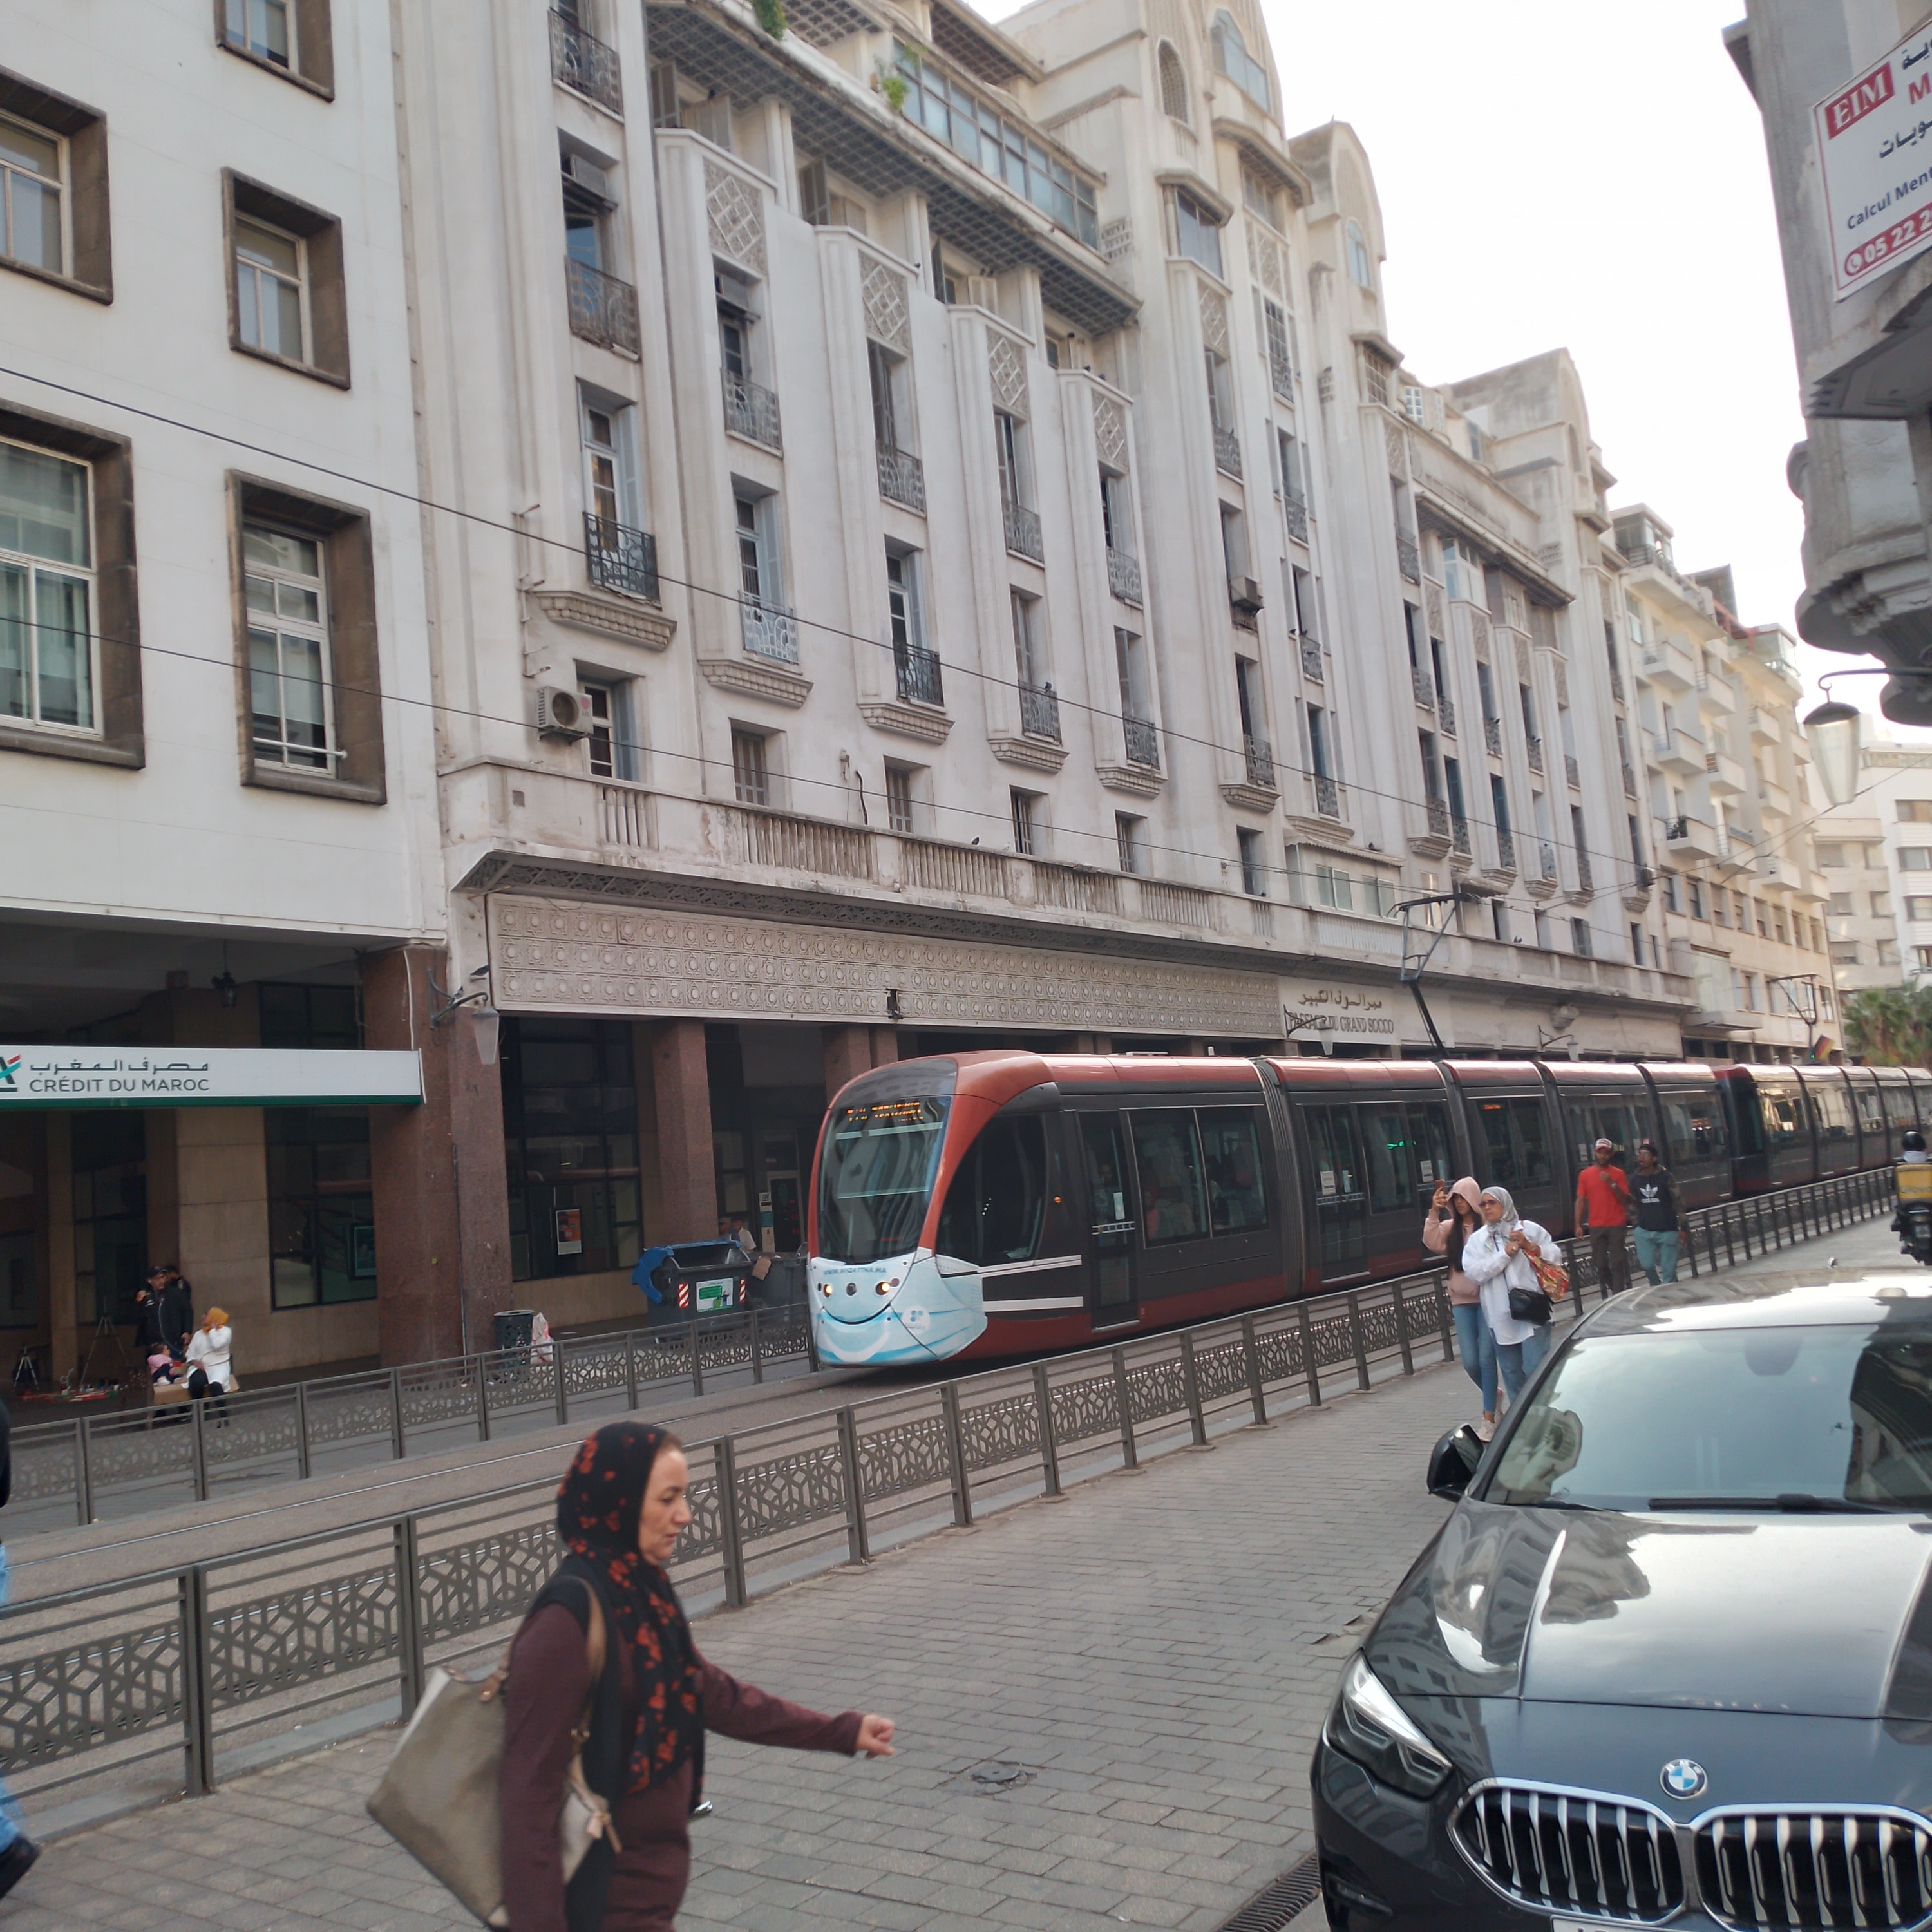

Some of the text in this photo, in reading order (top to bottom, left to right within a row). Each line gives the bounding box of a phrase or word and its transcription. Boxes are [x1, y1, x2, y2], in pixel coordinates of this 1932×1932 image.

[1832, 71, 1889, 129] EIM
[1847, 192, 1891, 230] Calcul
[1864, 236, 1888, 263] 05
[1891, 220, 1916, 249] 22
[1340, 1016, 1367, 1032] GRAND
[1368, 1018, 1394, 1034] SOCCO
[30, 1057, 209, 1075] مصرف المغرب
[29, 1076, 209, 1092] CRÉDIT DU MAROC
